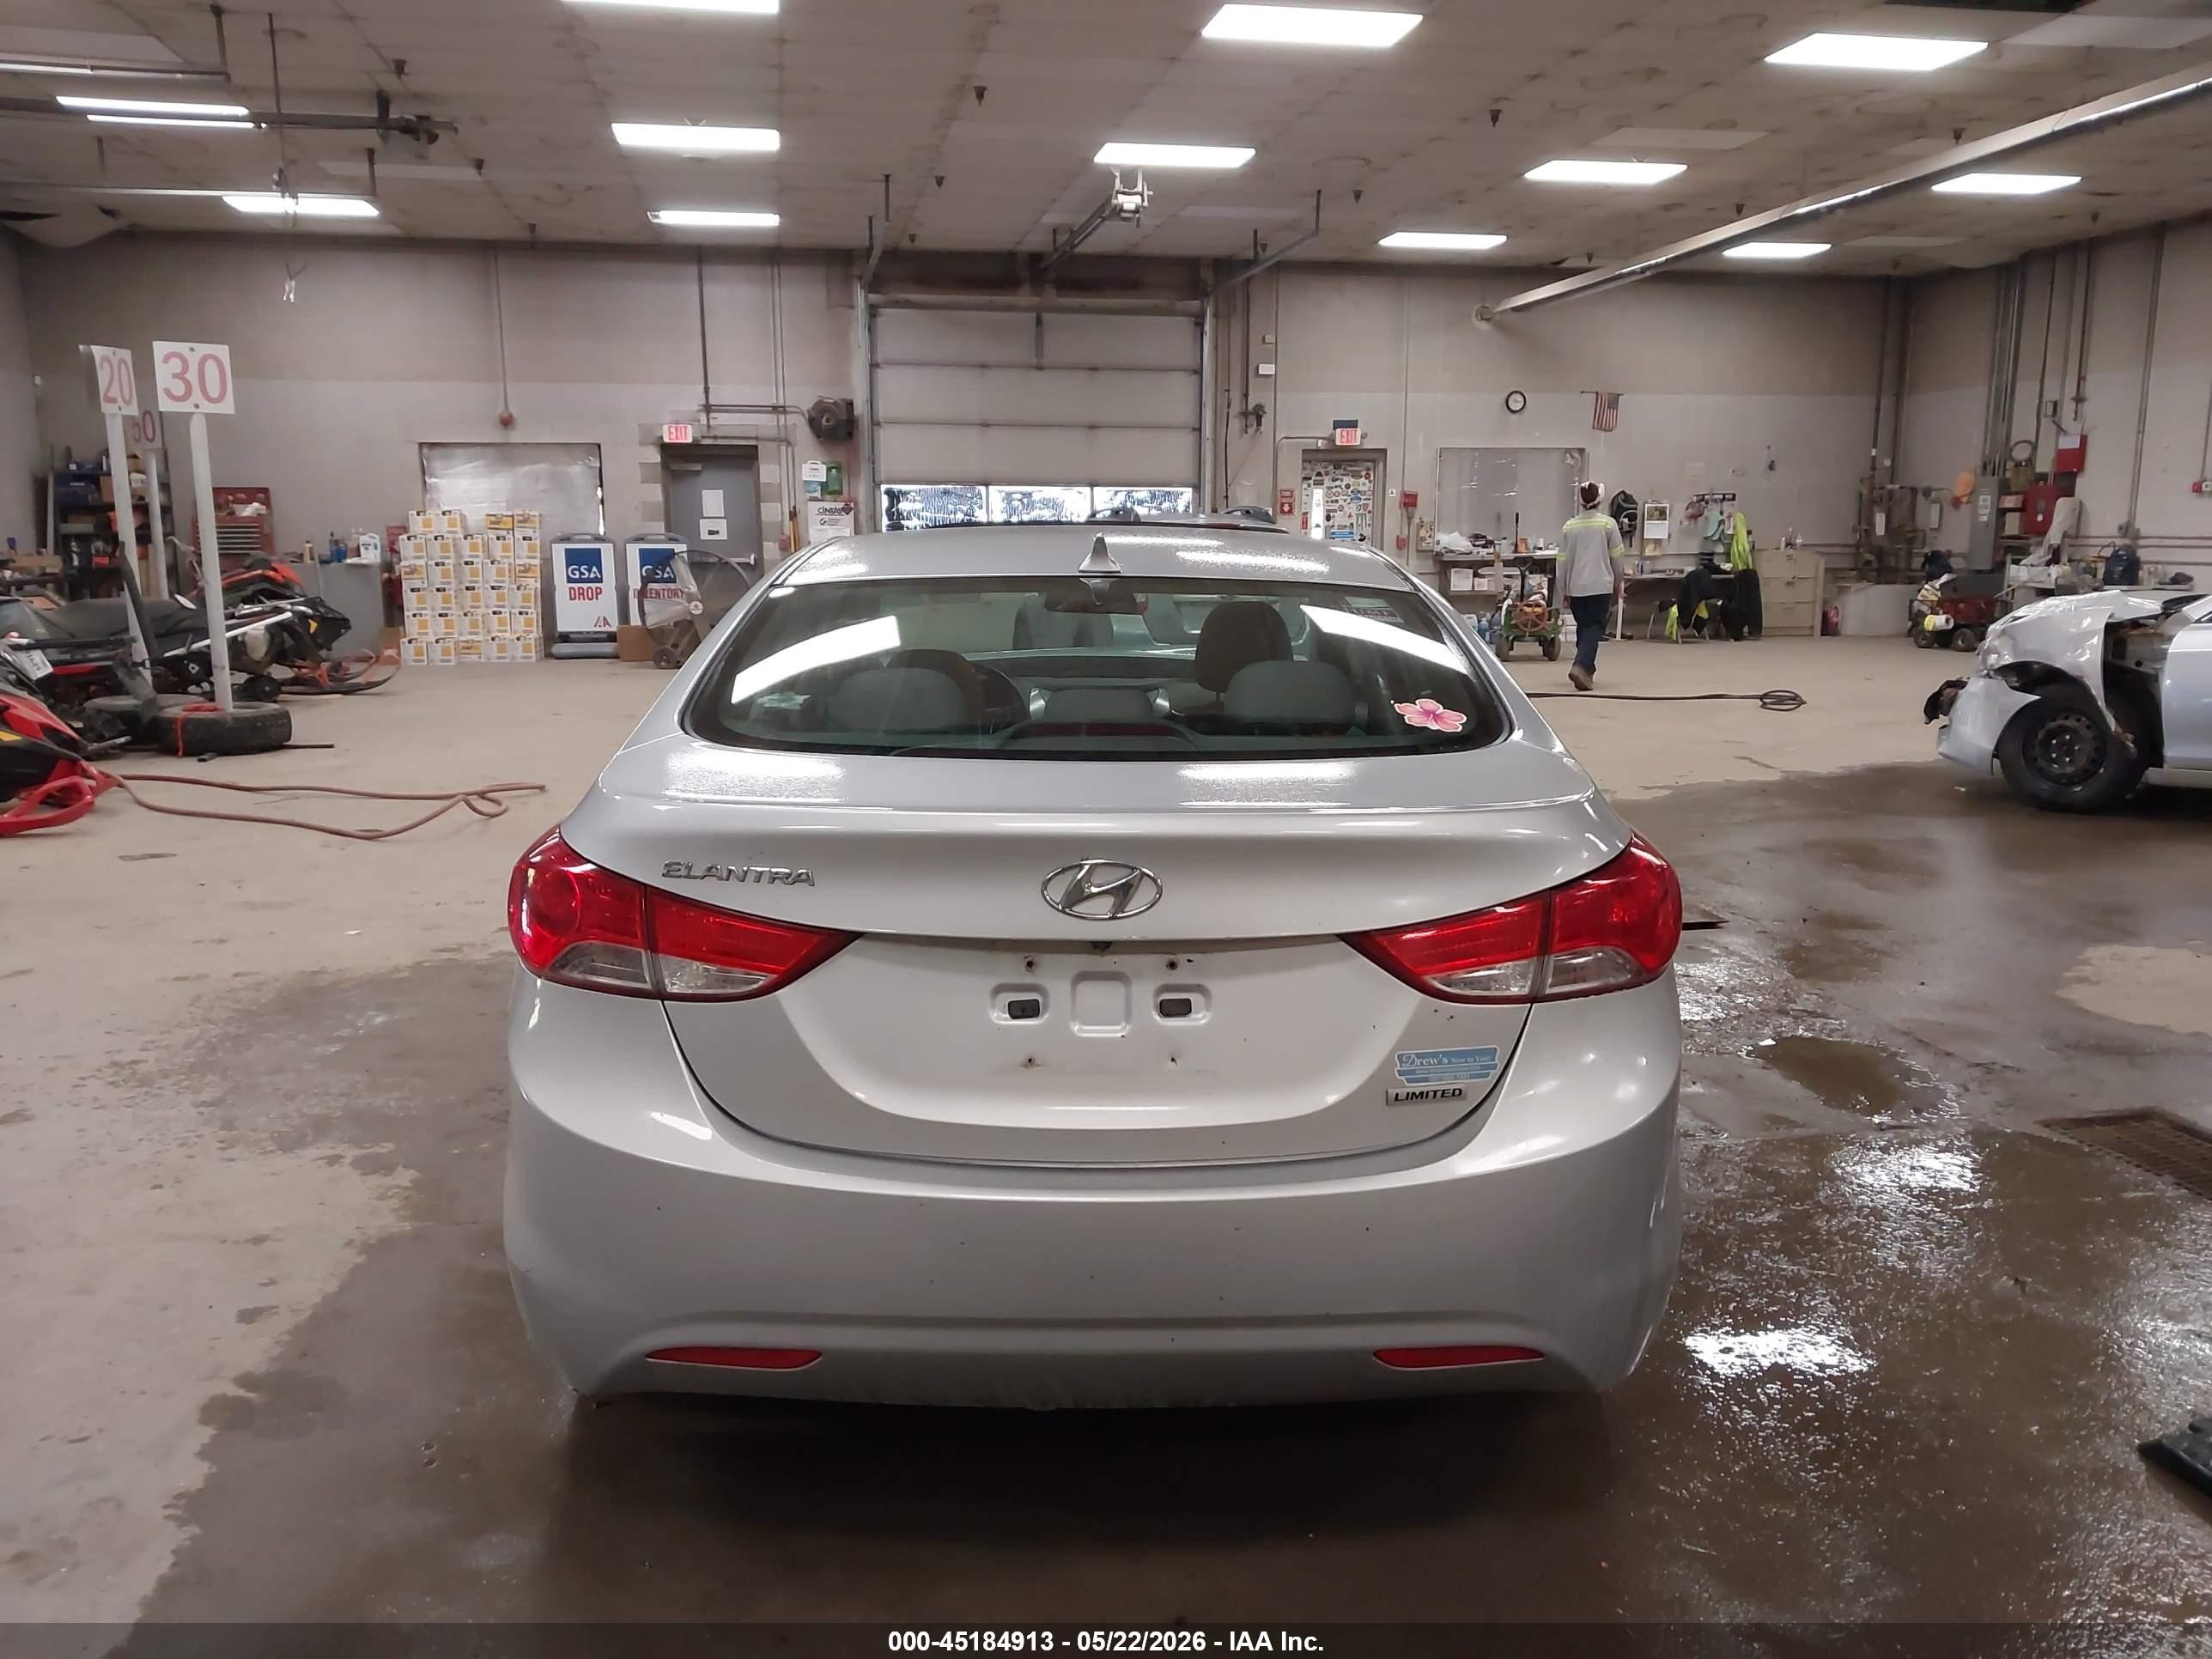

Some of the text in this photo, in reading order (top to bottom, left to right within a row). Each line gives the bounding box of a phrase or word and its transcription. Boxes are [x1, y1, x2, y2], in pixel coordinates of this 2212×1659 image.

[99, 355, 134, 406] 20
[161, 350, 228, 404] 30
[668, 425, 688, 441] EXIT
[1340, 428, 1358, 444] EXIT
[568, 564, 601, 579] GSA
[568, 586, 603, 601] DROP
[632, 587, 684, 599] IENTORY
[661, 860, 815, 887] ELANTRA
[1401, 1053, 1449, 1067] Drew's
[1394, 1087, 1463, 1103] LIMITED
